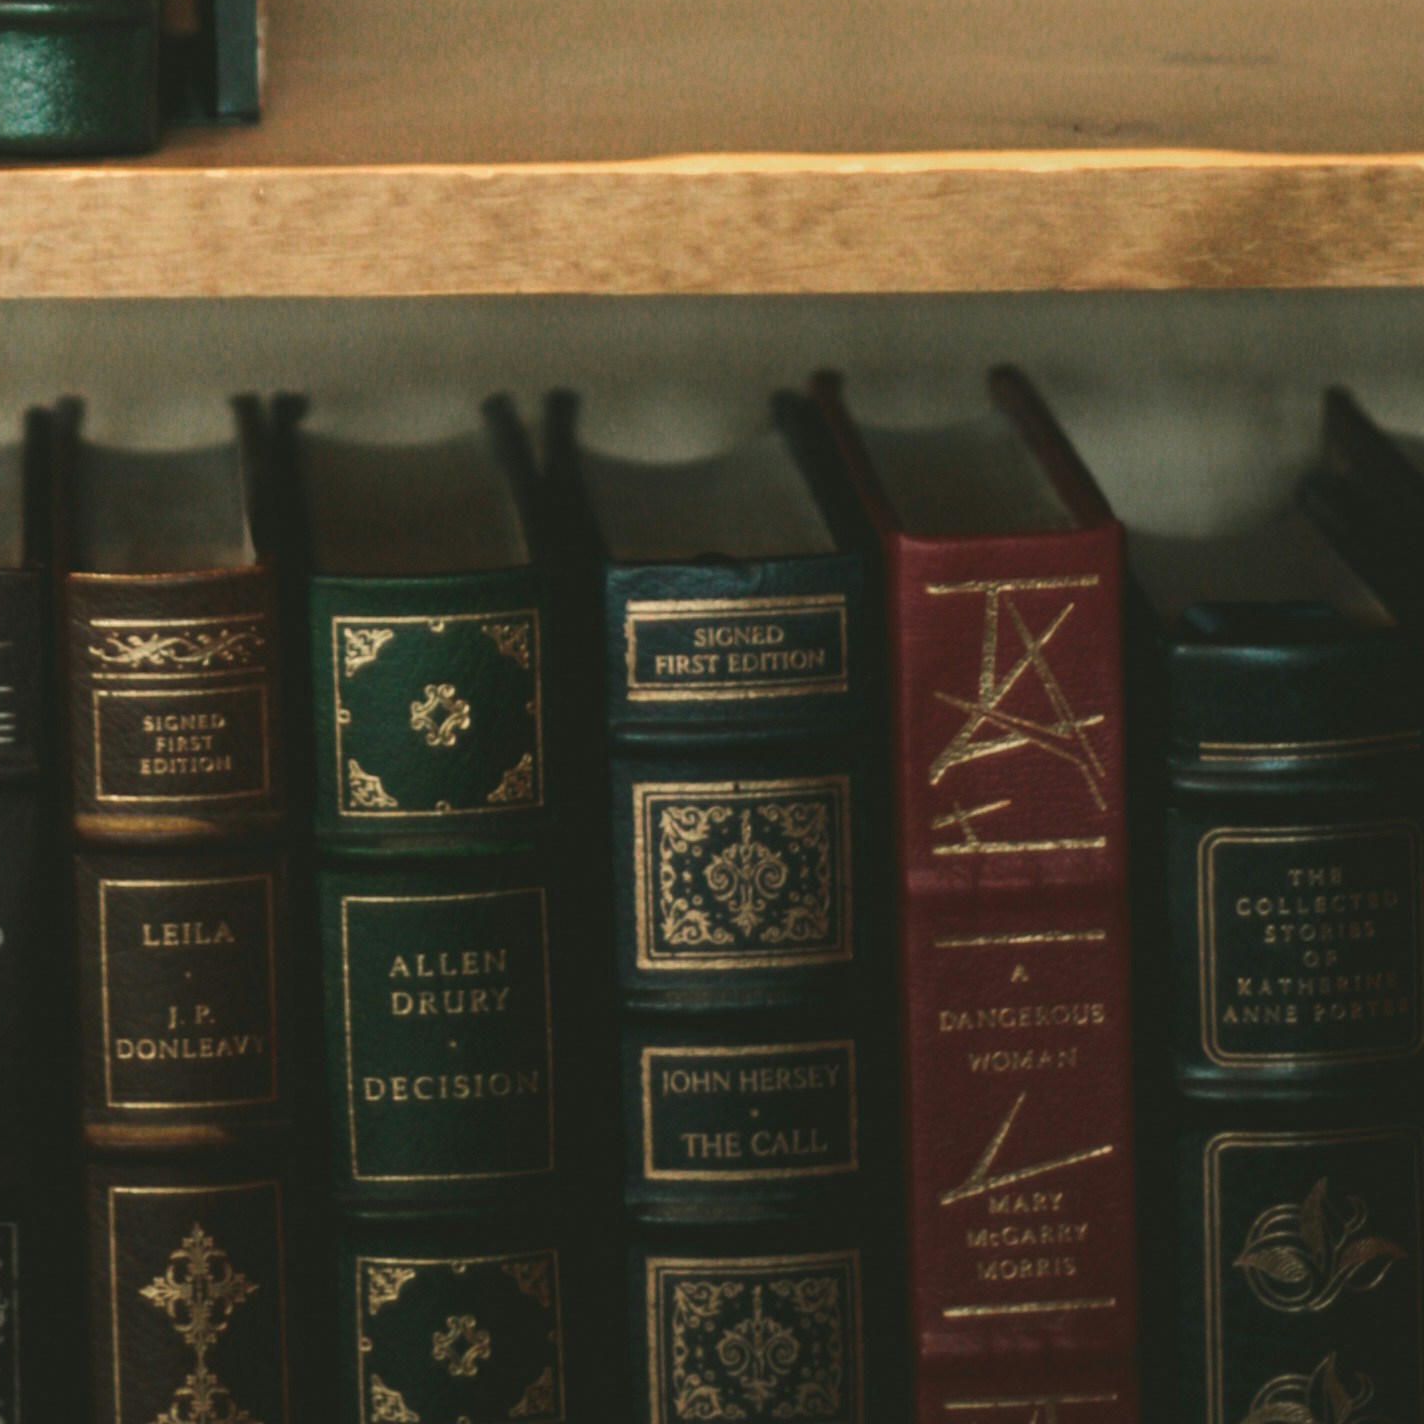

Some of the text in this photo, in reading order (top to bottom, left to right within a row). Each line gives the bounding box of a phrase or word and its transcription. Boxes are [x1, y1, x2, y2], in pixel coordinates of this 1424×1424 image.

[693, 625, 784, 648] SIGNED
[655, 648, 825, 675] FIRST EDITION
[142, 712, 226, 733] SIGNED
[156, 734, 213, 753] FIRST
[138, 754, 232, 775] EDITION
[1287, 867, 1343, 886] THE
[1235, 891, 1398, 916] COLLECTED
[142, 921, 236, 947] LEILA
[1264, 920, 1375, 943] STORIES
[389, 950, 507, 978] ALLEN
[1010, 962, 1029, 983] A
[391, 987, 510, 1016] DRURY
[1223, 1003, 1298, 1023] ANNE
[167, 1004, 216, 1030] J. P.
[939, 1003, 1106, 1032] DANGEROUS
[116, 1035, 266, 1061] DONLEAVY
[968, 1047, 1077, 1072] WOMAN
[363, 1070, 539, 1101] DECISION
[661, 1064, 840, 1096] JOHN HERSEY
[680, 1128, 828, 1158] THE CALL
[988, 1192, 1064, 1214] MARY
[967, 1223, 1089, 1248] McGARRY
[977, 1256, 1077, 1280] MORRIS
